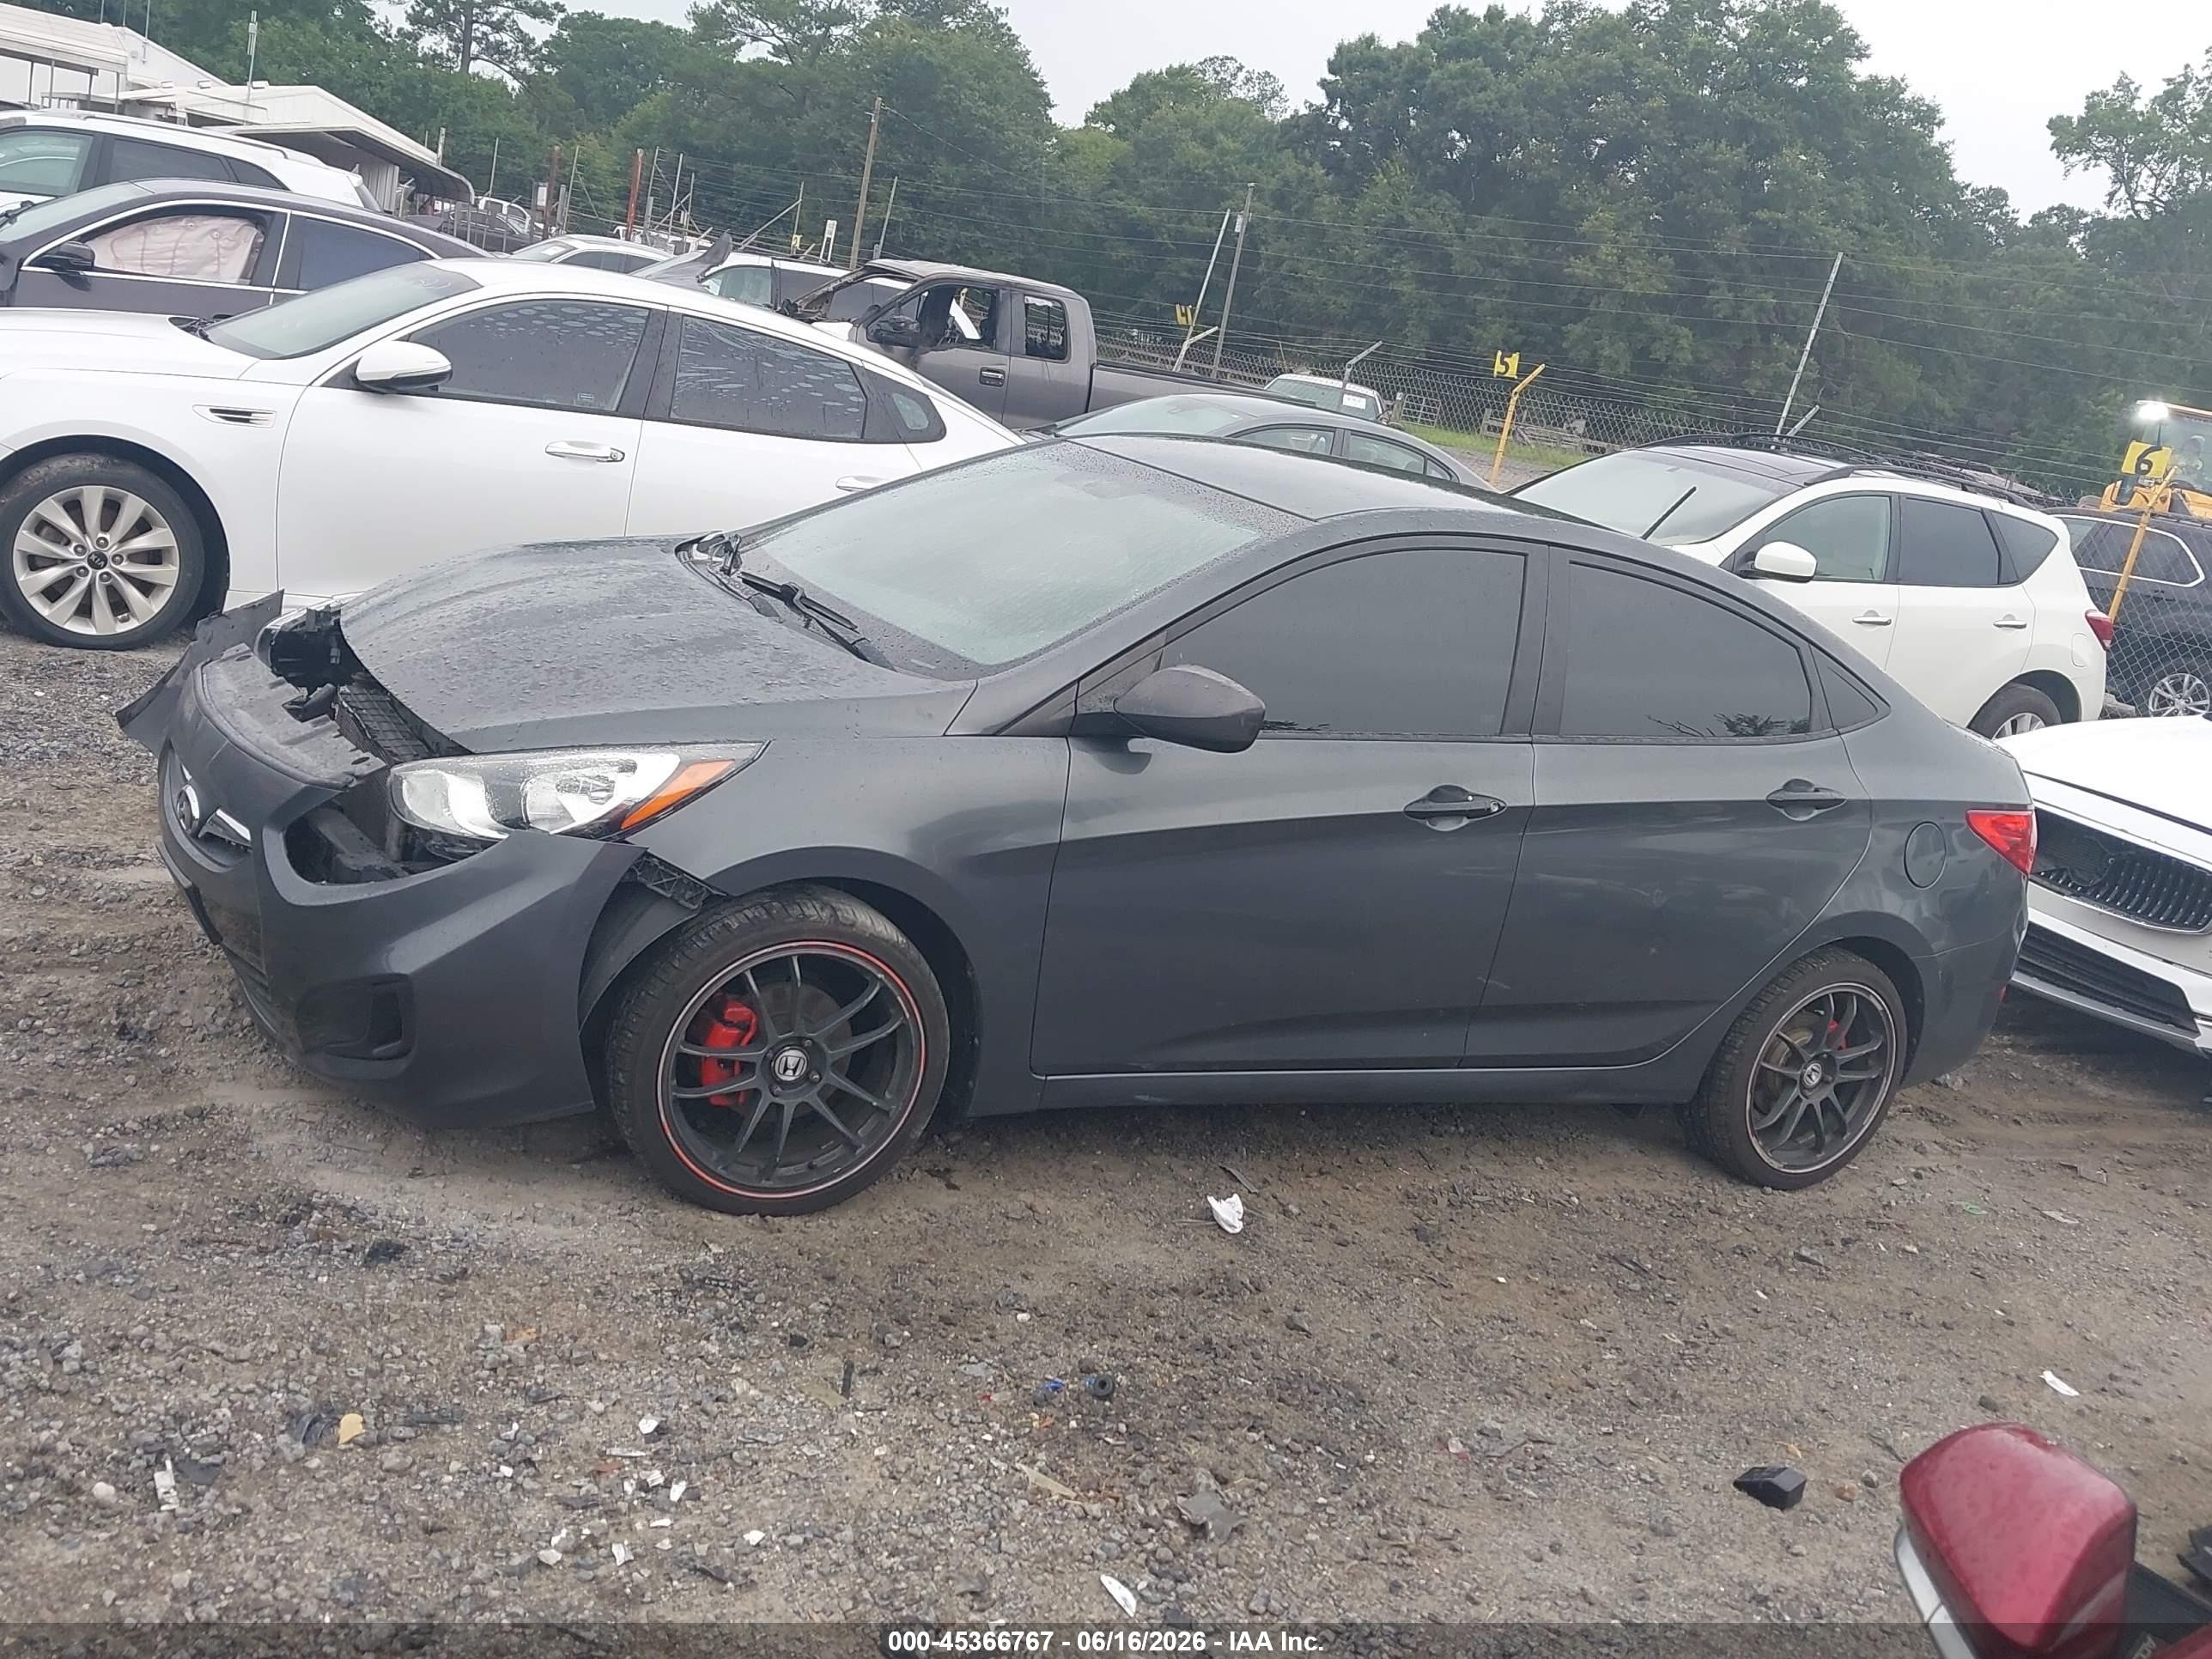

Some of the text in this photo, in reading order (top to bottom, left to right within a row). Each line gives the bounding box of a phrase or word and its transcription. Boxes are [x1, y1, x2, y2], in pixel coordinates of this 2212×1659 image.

[1178, 305, 1190, 325] 4
[1496, 351, 1513, 375] 5
[2135, 443, 2163, 476] 6
[89, 553, 106, 568] KIA
